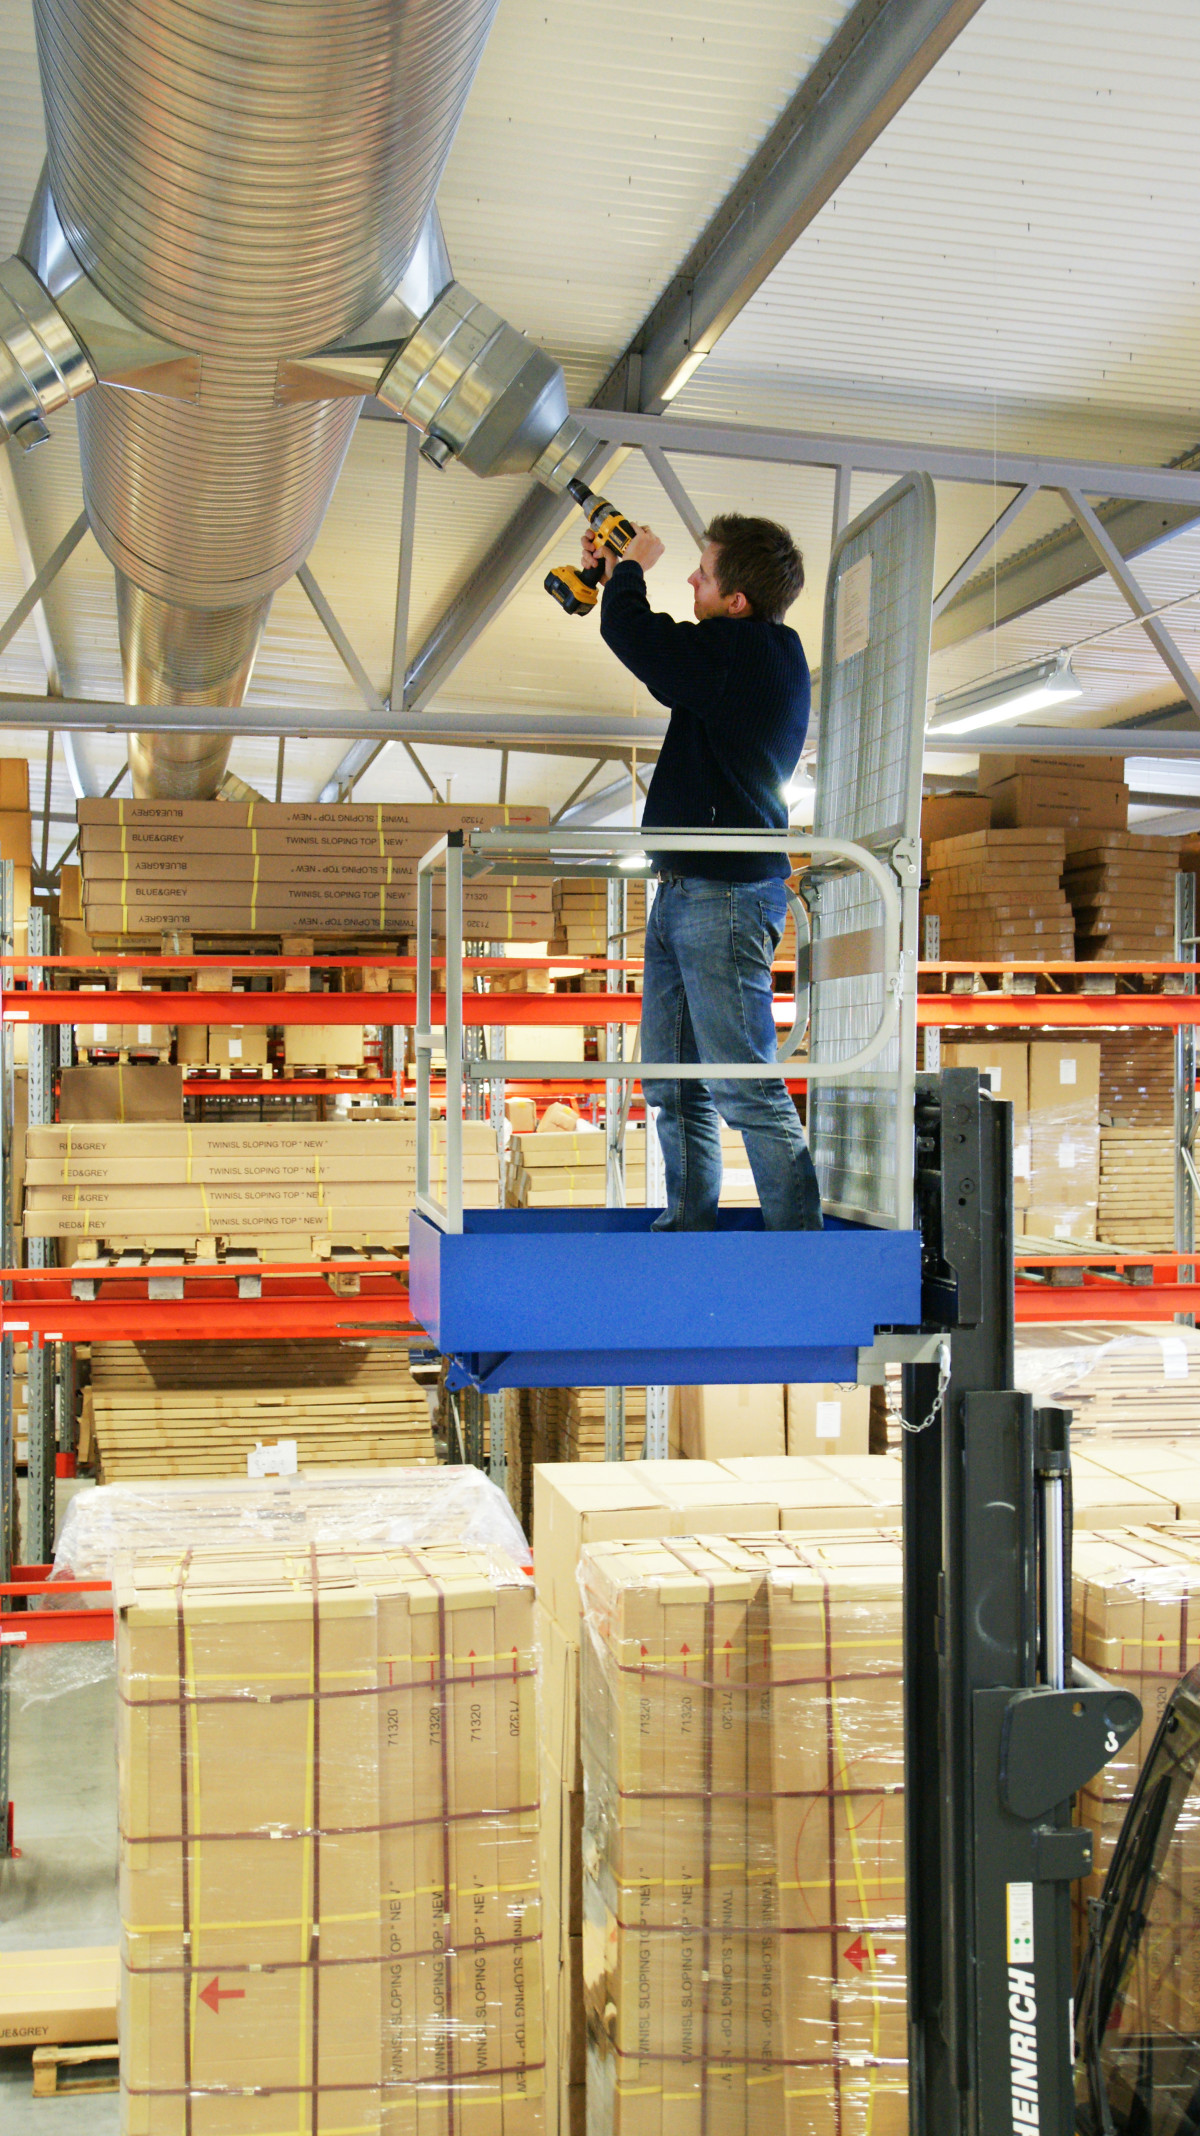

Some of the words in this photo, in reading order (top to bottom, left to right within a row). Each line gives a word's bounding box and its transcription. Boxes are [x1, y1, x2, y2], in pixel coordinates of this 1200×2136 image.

[131, 809, 183, 817] BLUE&GREY
[338, 814, 374, 822] SLOPING
[376, 815, 408, 823] TWINIS
[132, 834, 184, 842] BLUE&GREY
[321, 837, 358, 845] SLOPING
[380, 866, 413, 874] TWINSL
[136, 888, 187, 896] BLUE&GREY
[138, 915, 190, 923] BLUE&GREY
[467, 920, 489, 928] 71320
[722, 1692, 732, 1730] 71320
[640, 1698, 650, 1735] 71320
[681, 1697, 692, 1734] 71320
[429, 1708, 440, 1746] 71320
[471, 1704, 481, 1742] 71320
[387, 1709, 398, 1747] 71320
[639, 1950, 650, 2009] SLOPING
[681, 1948, 692, 2008] SLOPING
